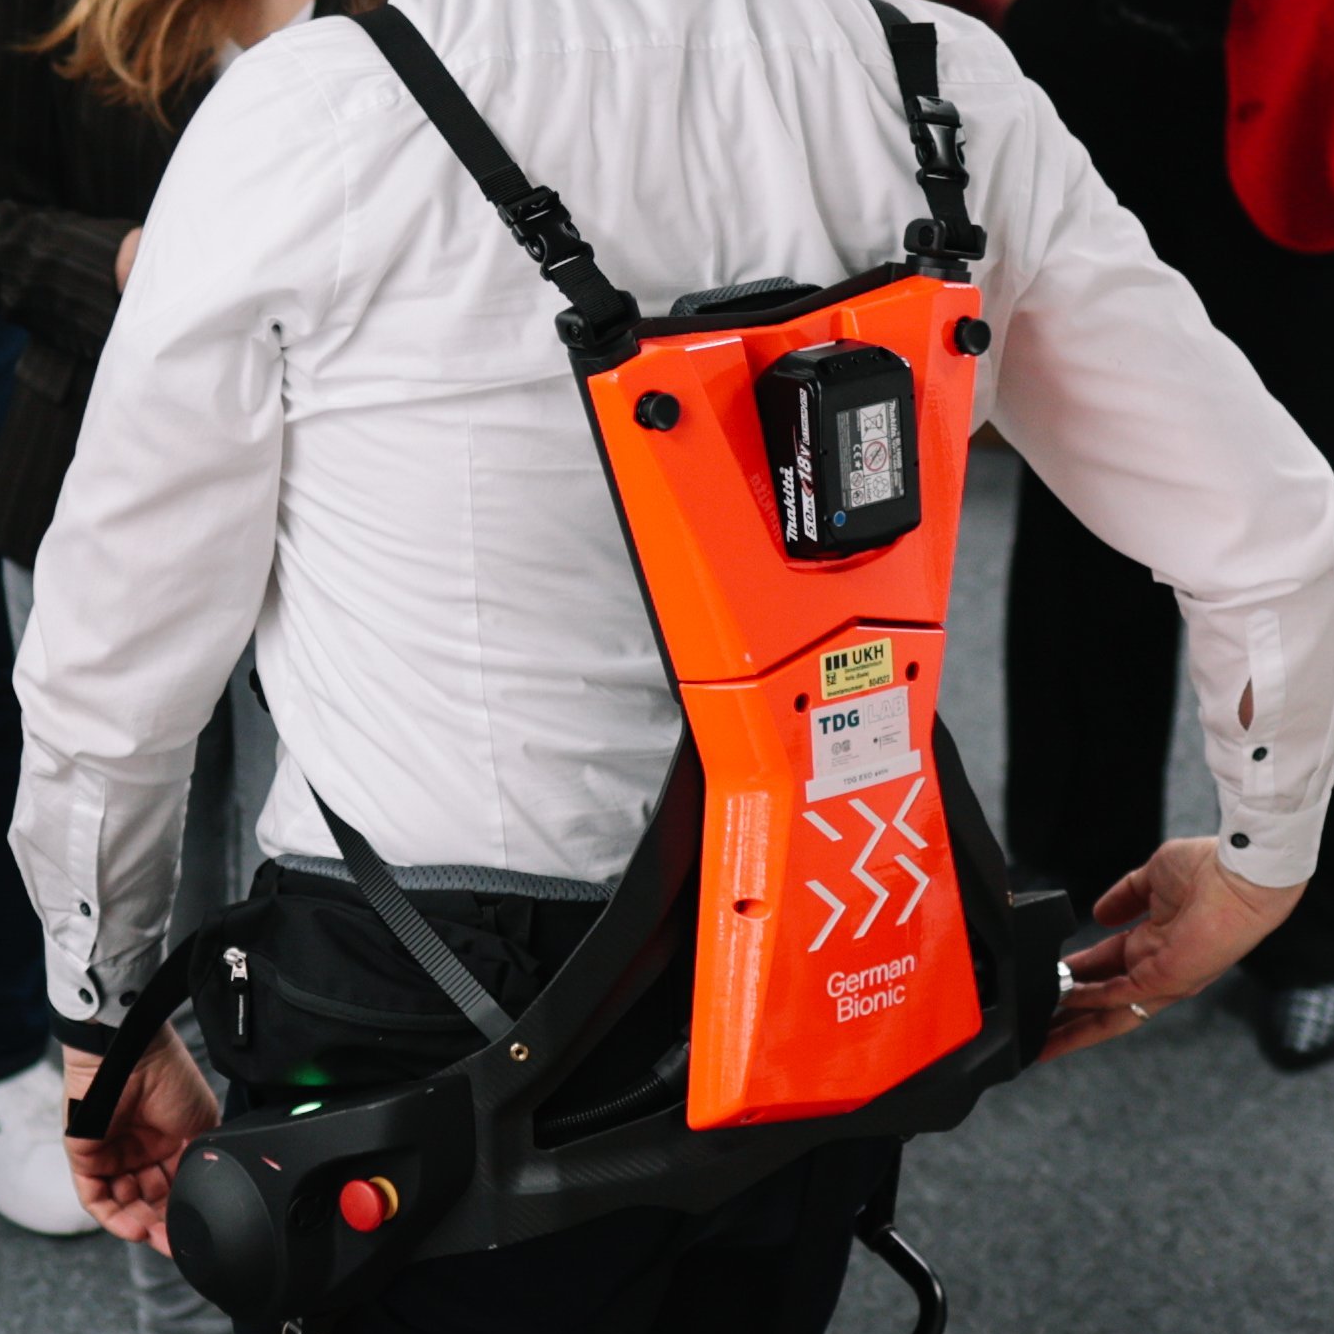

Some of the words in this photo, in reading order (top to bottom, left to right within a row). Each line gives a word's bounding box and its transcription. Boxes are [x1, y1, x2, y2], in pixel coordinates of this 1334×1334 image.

[781, 466, 798, 542] makita
[853, 644, 884, 665] UKH
[818, 709, 860, 735] TDG
[827, 955, 915, 998] German
[837, 982, 906, 1023] Bionic
